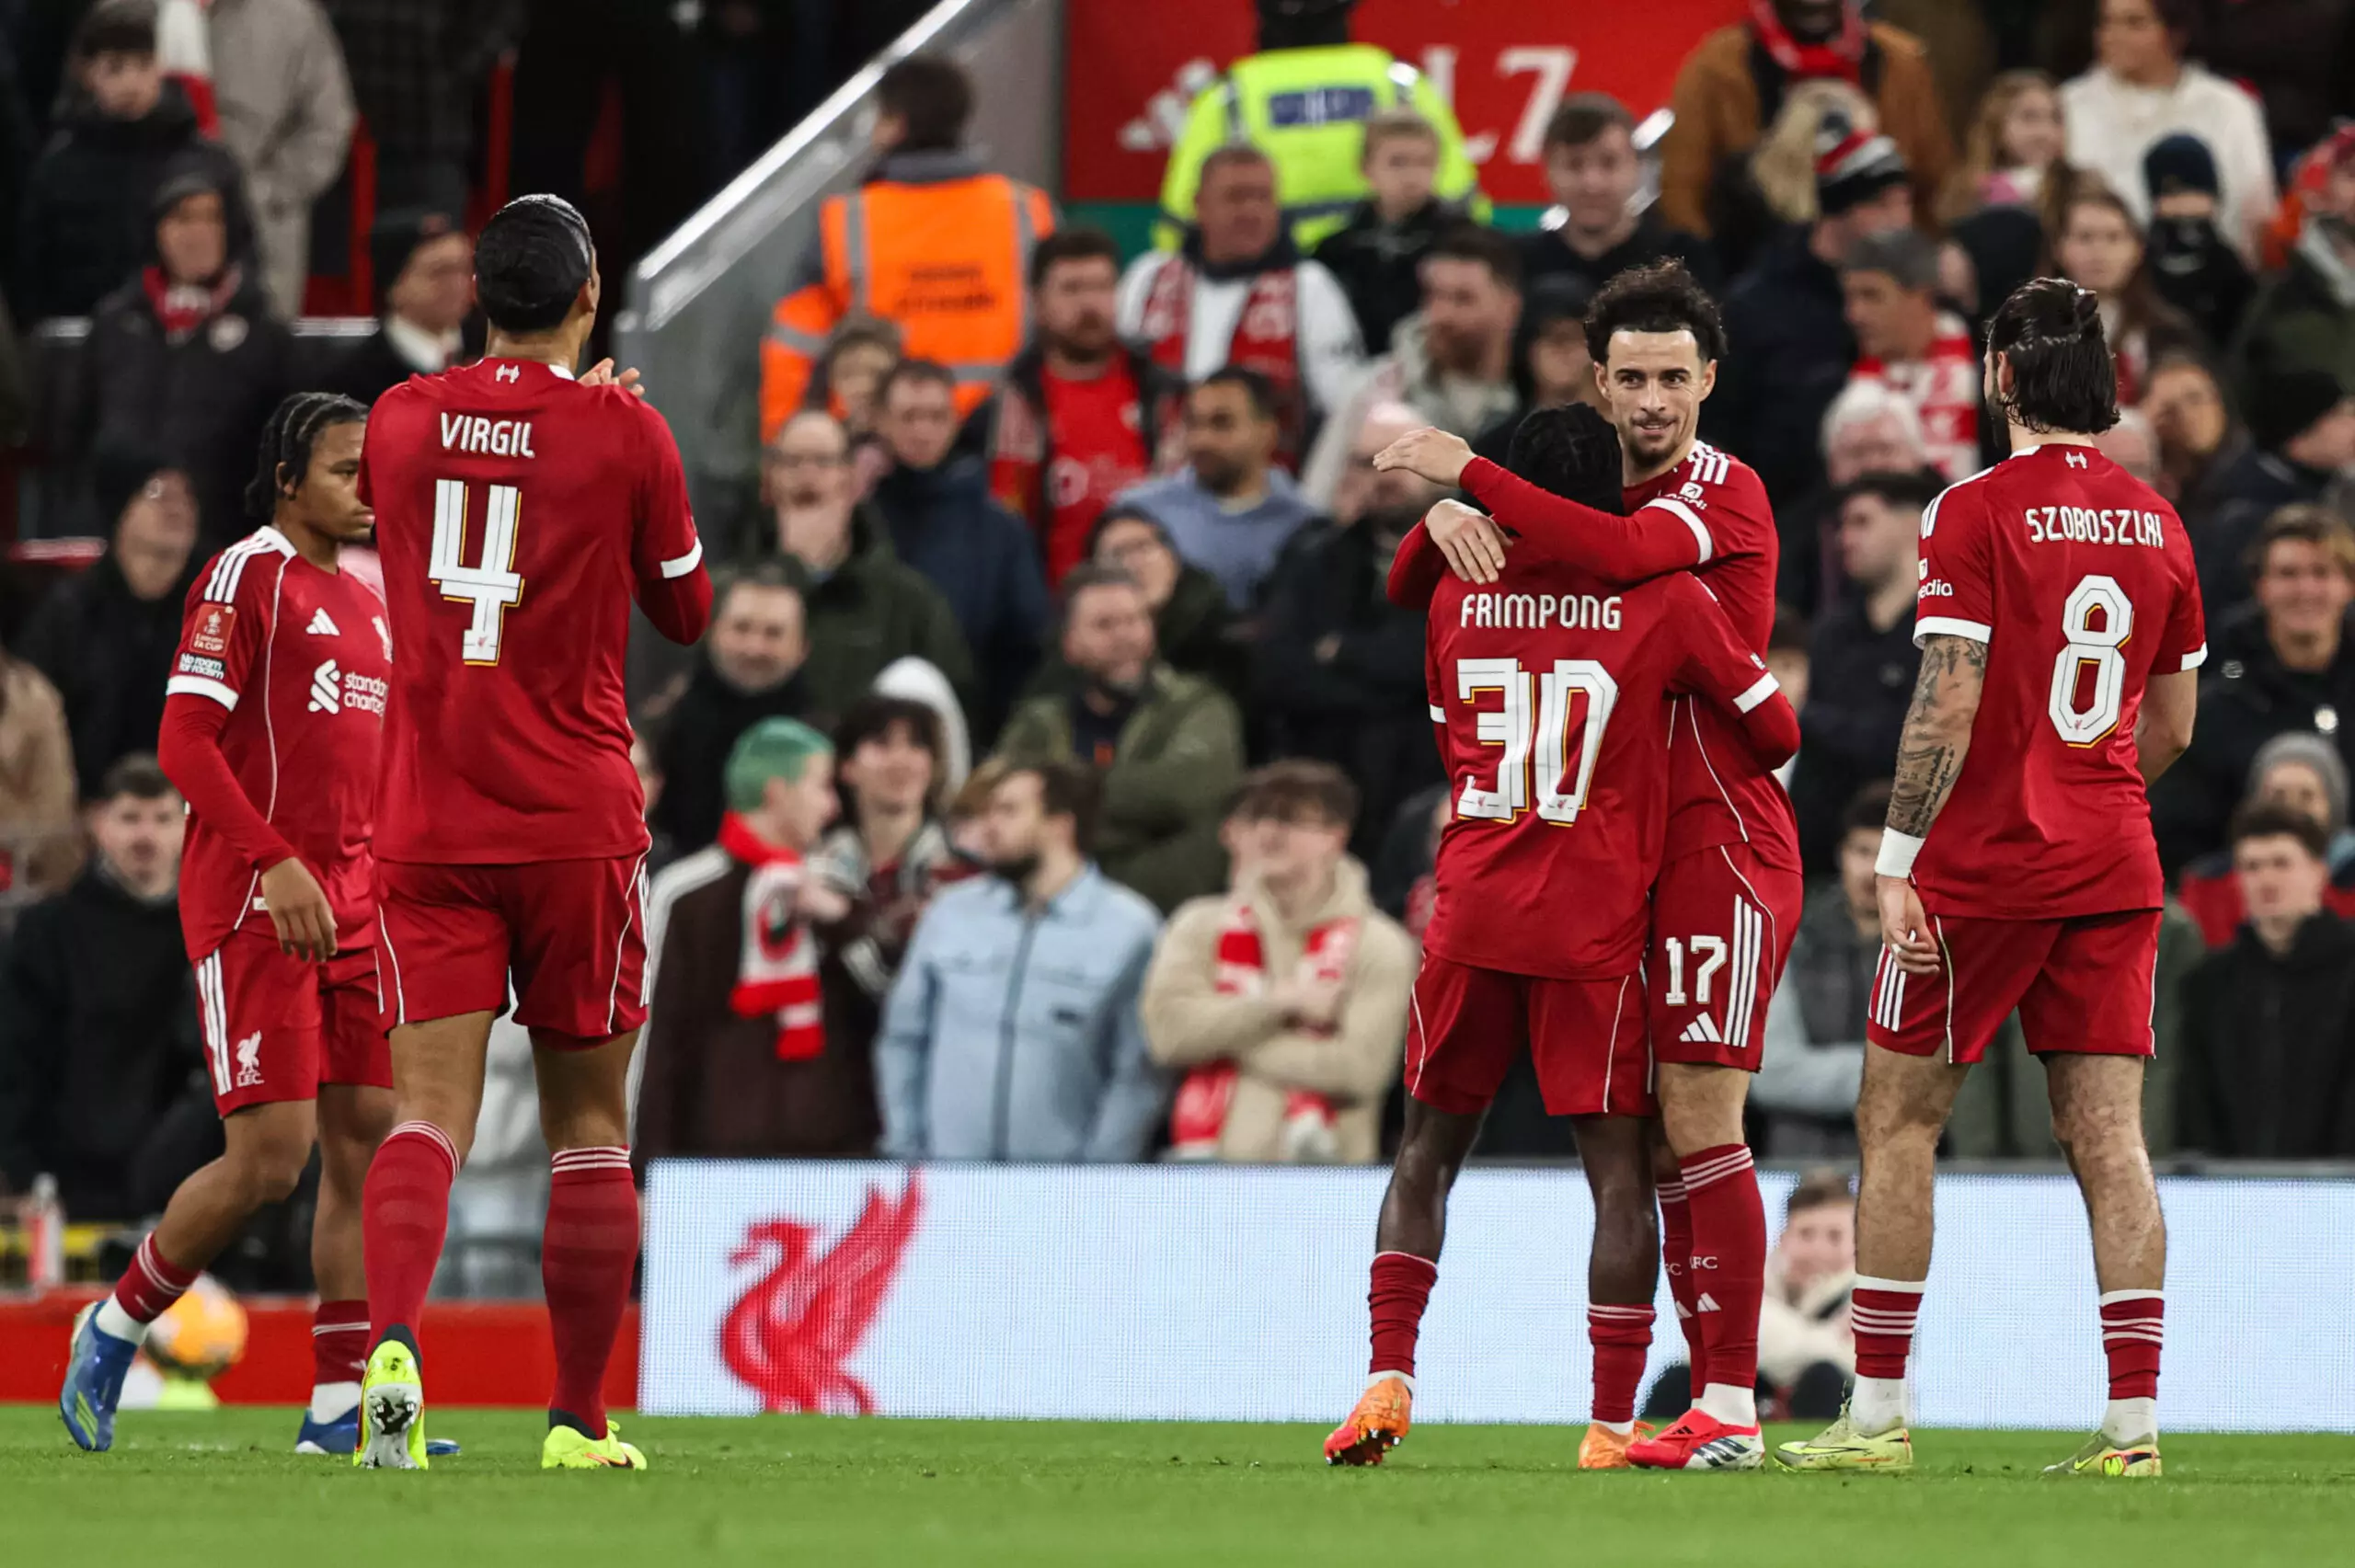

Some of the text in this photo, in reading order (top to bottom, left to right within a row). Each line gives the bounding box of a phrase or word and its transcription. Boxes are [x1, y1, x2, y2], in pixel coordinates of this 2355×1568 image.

[441, 411, 535, 459] VIRGIL
[2026, 506, 2164, 548] SZOBOSZLAI
[428, 479, 525, 667] 4
[1918, 578, 1953, 599] edia
[1460, 592, 1623, 631] FRIMPONG
[2048, 574, 2134, 749] 8
[1456, 658, 1620, 827] 30
[1665, 934, 1729, 1006] 17
